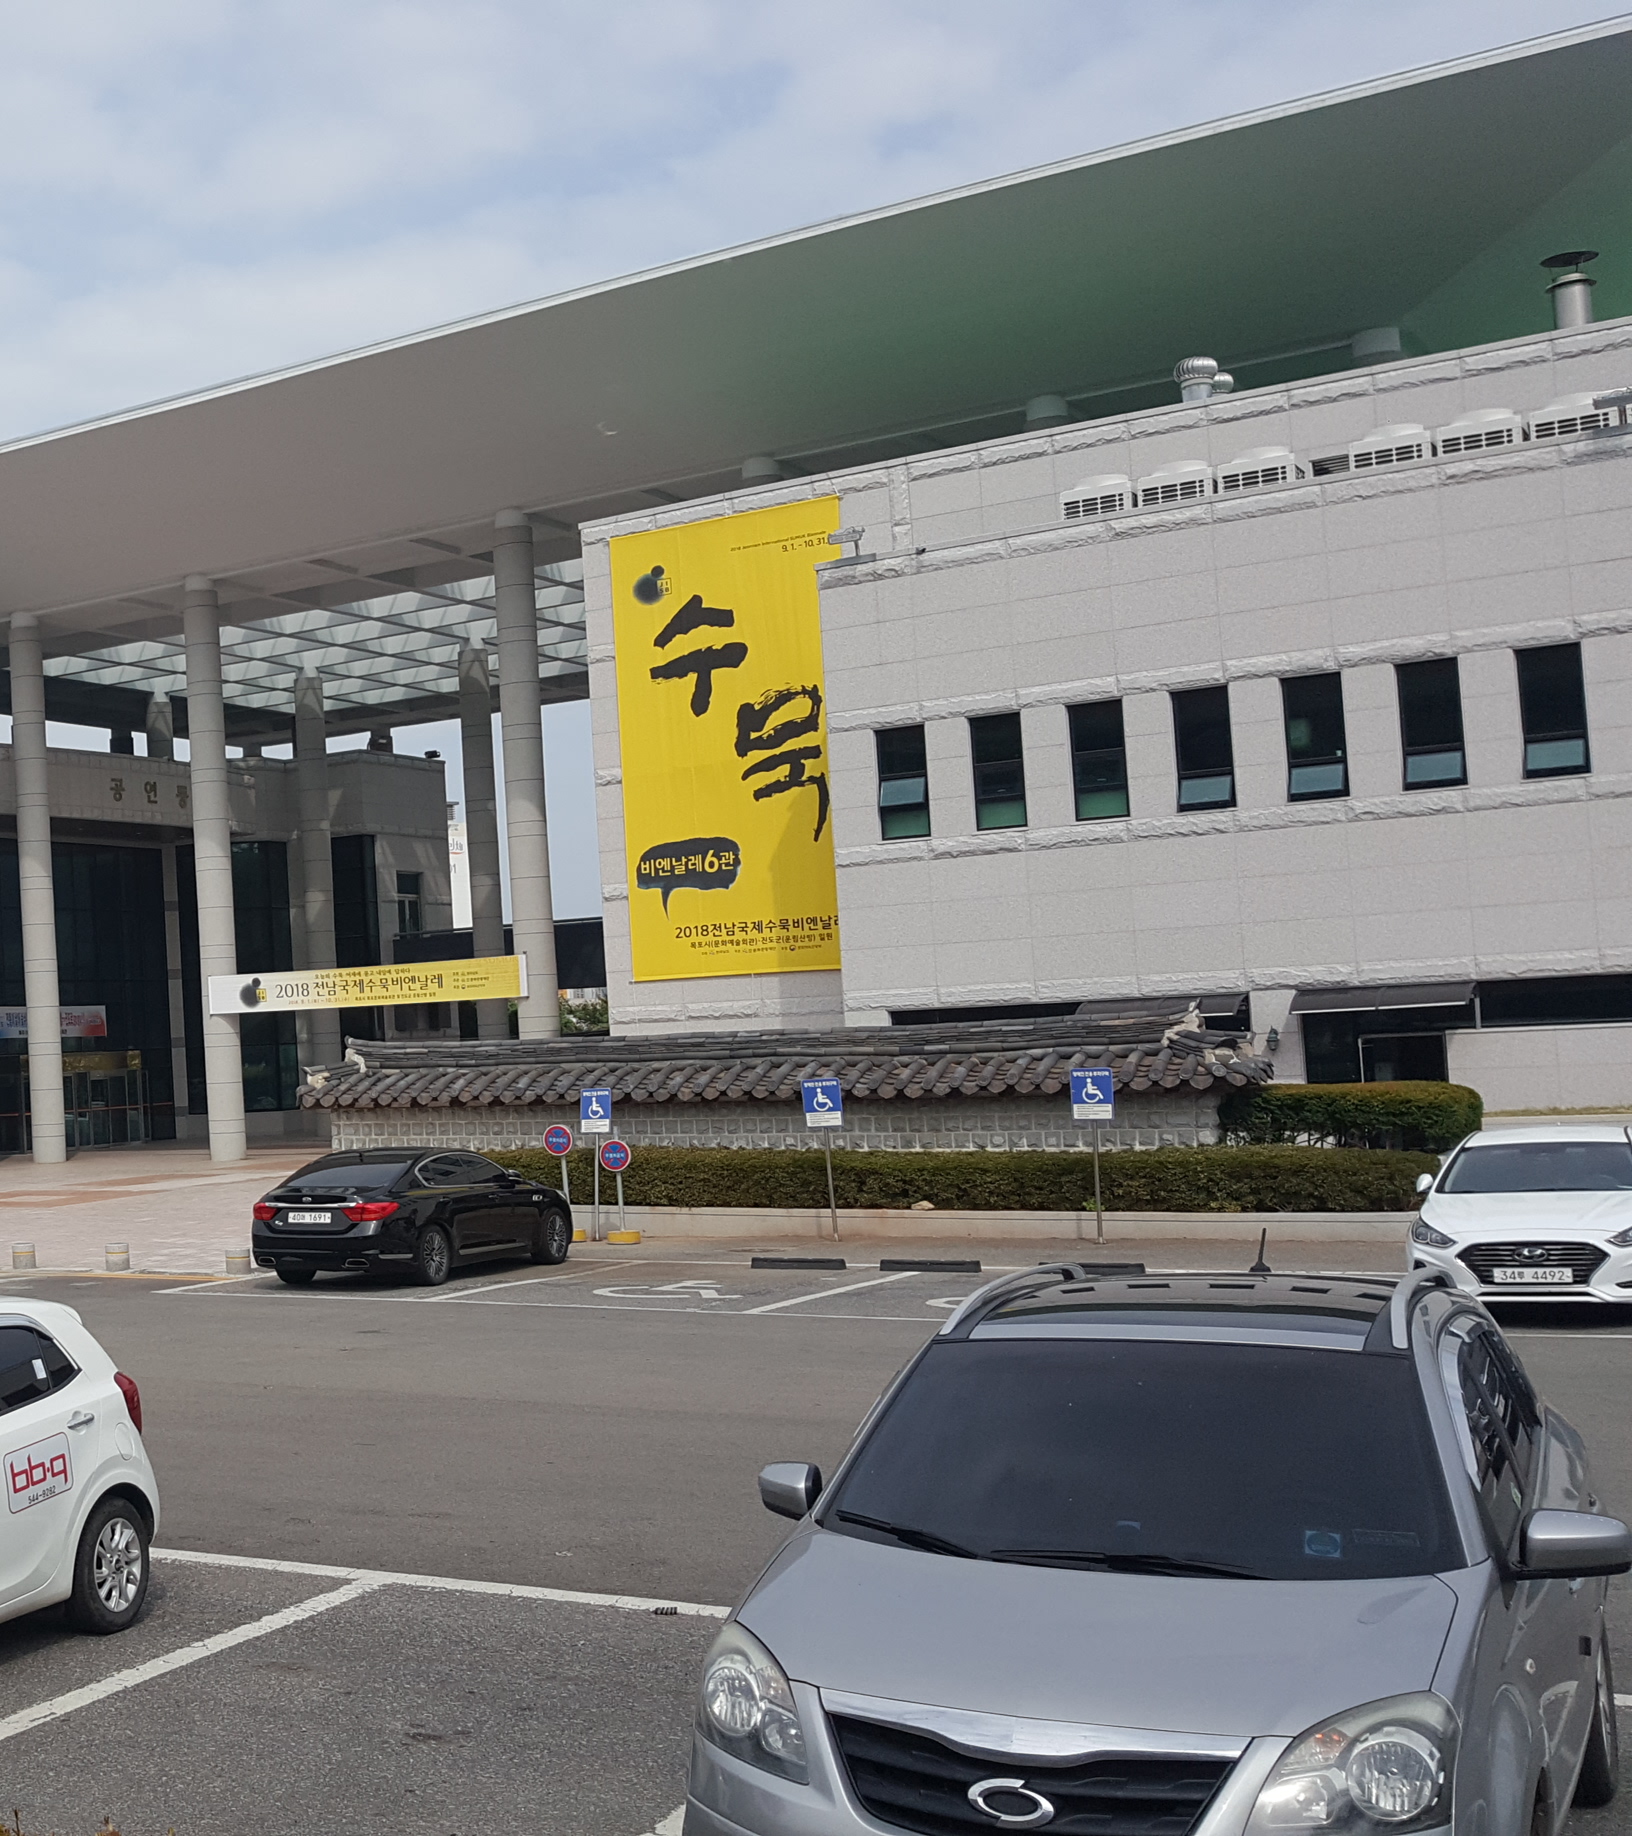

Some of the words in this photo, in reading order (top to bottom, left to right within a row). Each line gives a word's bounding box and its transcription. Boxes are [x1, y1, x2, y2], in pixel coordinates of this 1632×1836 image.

[640, 849, 735, 877] 비엔날레6관
[275, 982, 310, 999] 2018
[313, 974, 443, 997] 전남국제수묵비엔날레
[309, 1213, 327, 1222] 1691
[1531, 1270, 1565, 1281] 4492
